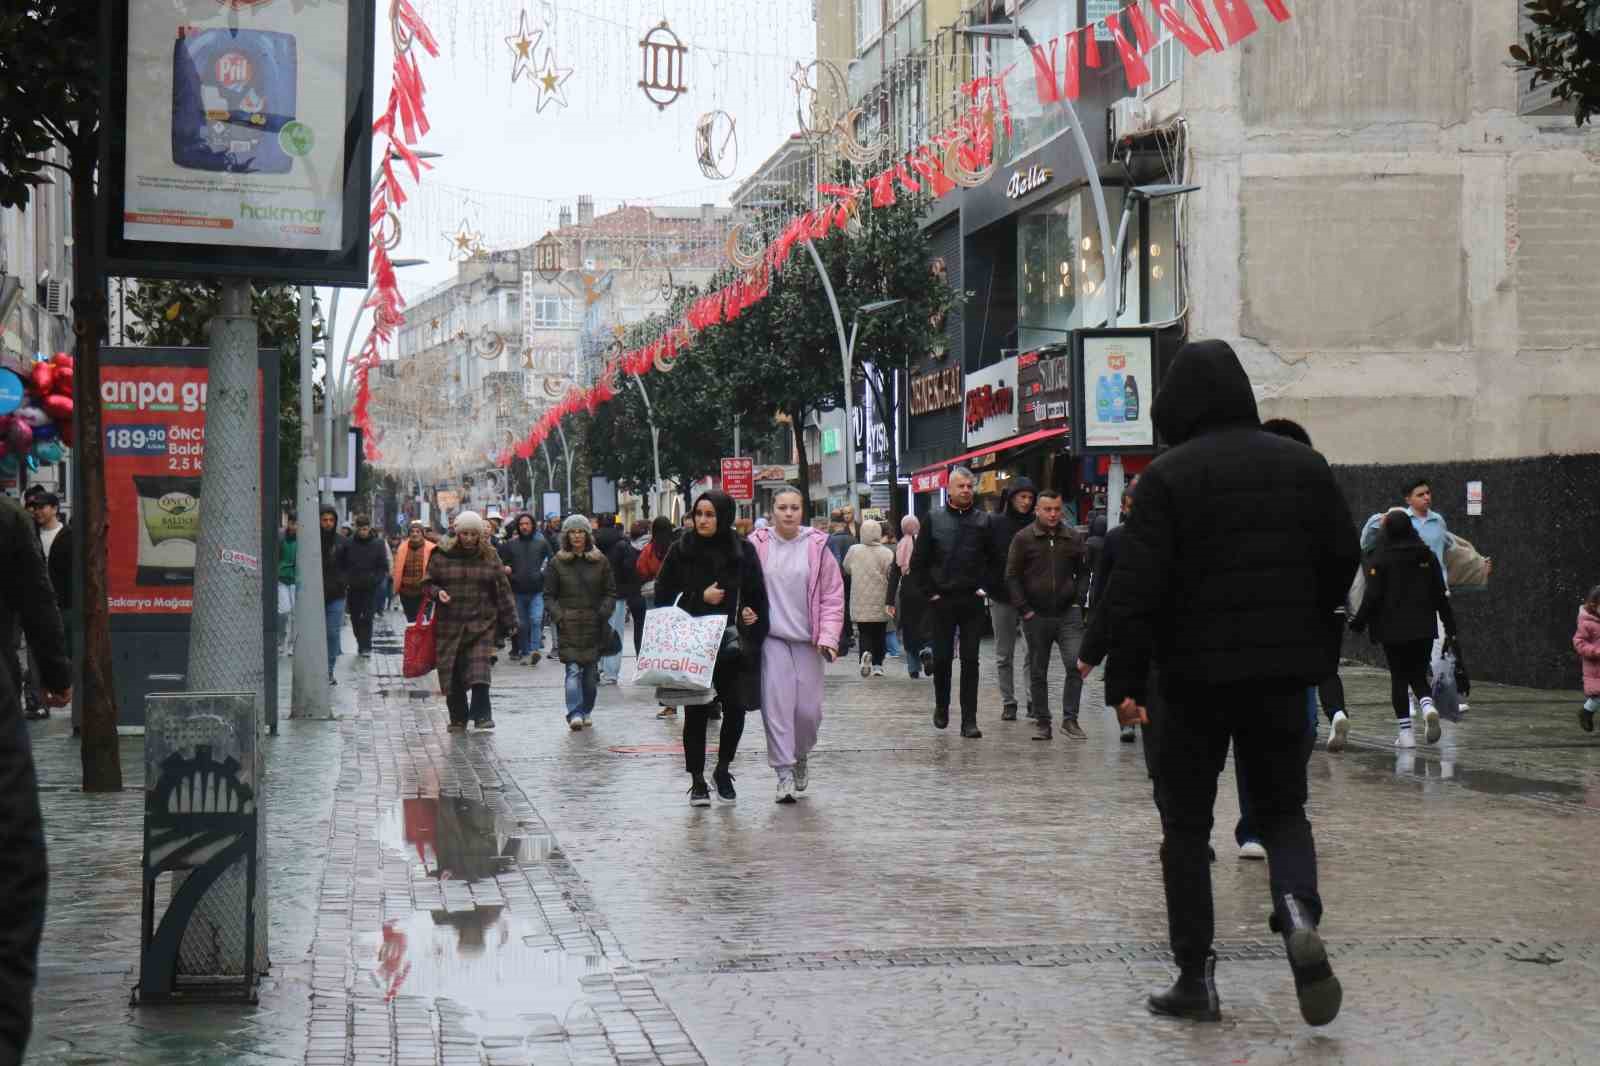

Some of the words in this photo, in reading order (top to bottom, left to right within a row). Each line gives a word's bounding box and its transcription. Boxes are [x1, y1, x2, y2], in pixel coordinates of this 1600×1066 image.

[220, 57, 247, 81] Pril
[240, 201, 326, 223] hakmar
[168, 443, 204, 455] Bald
